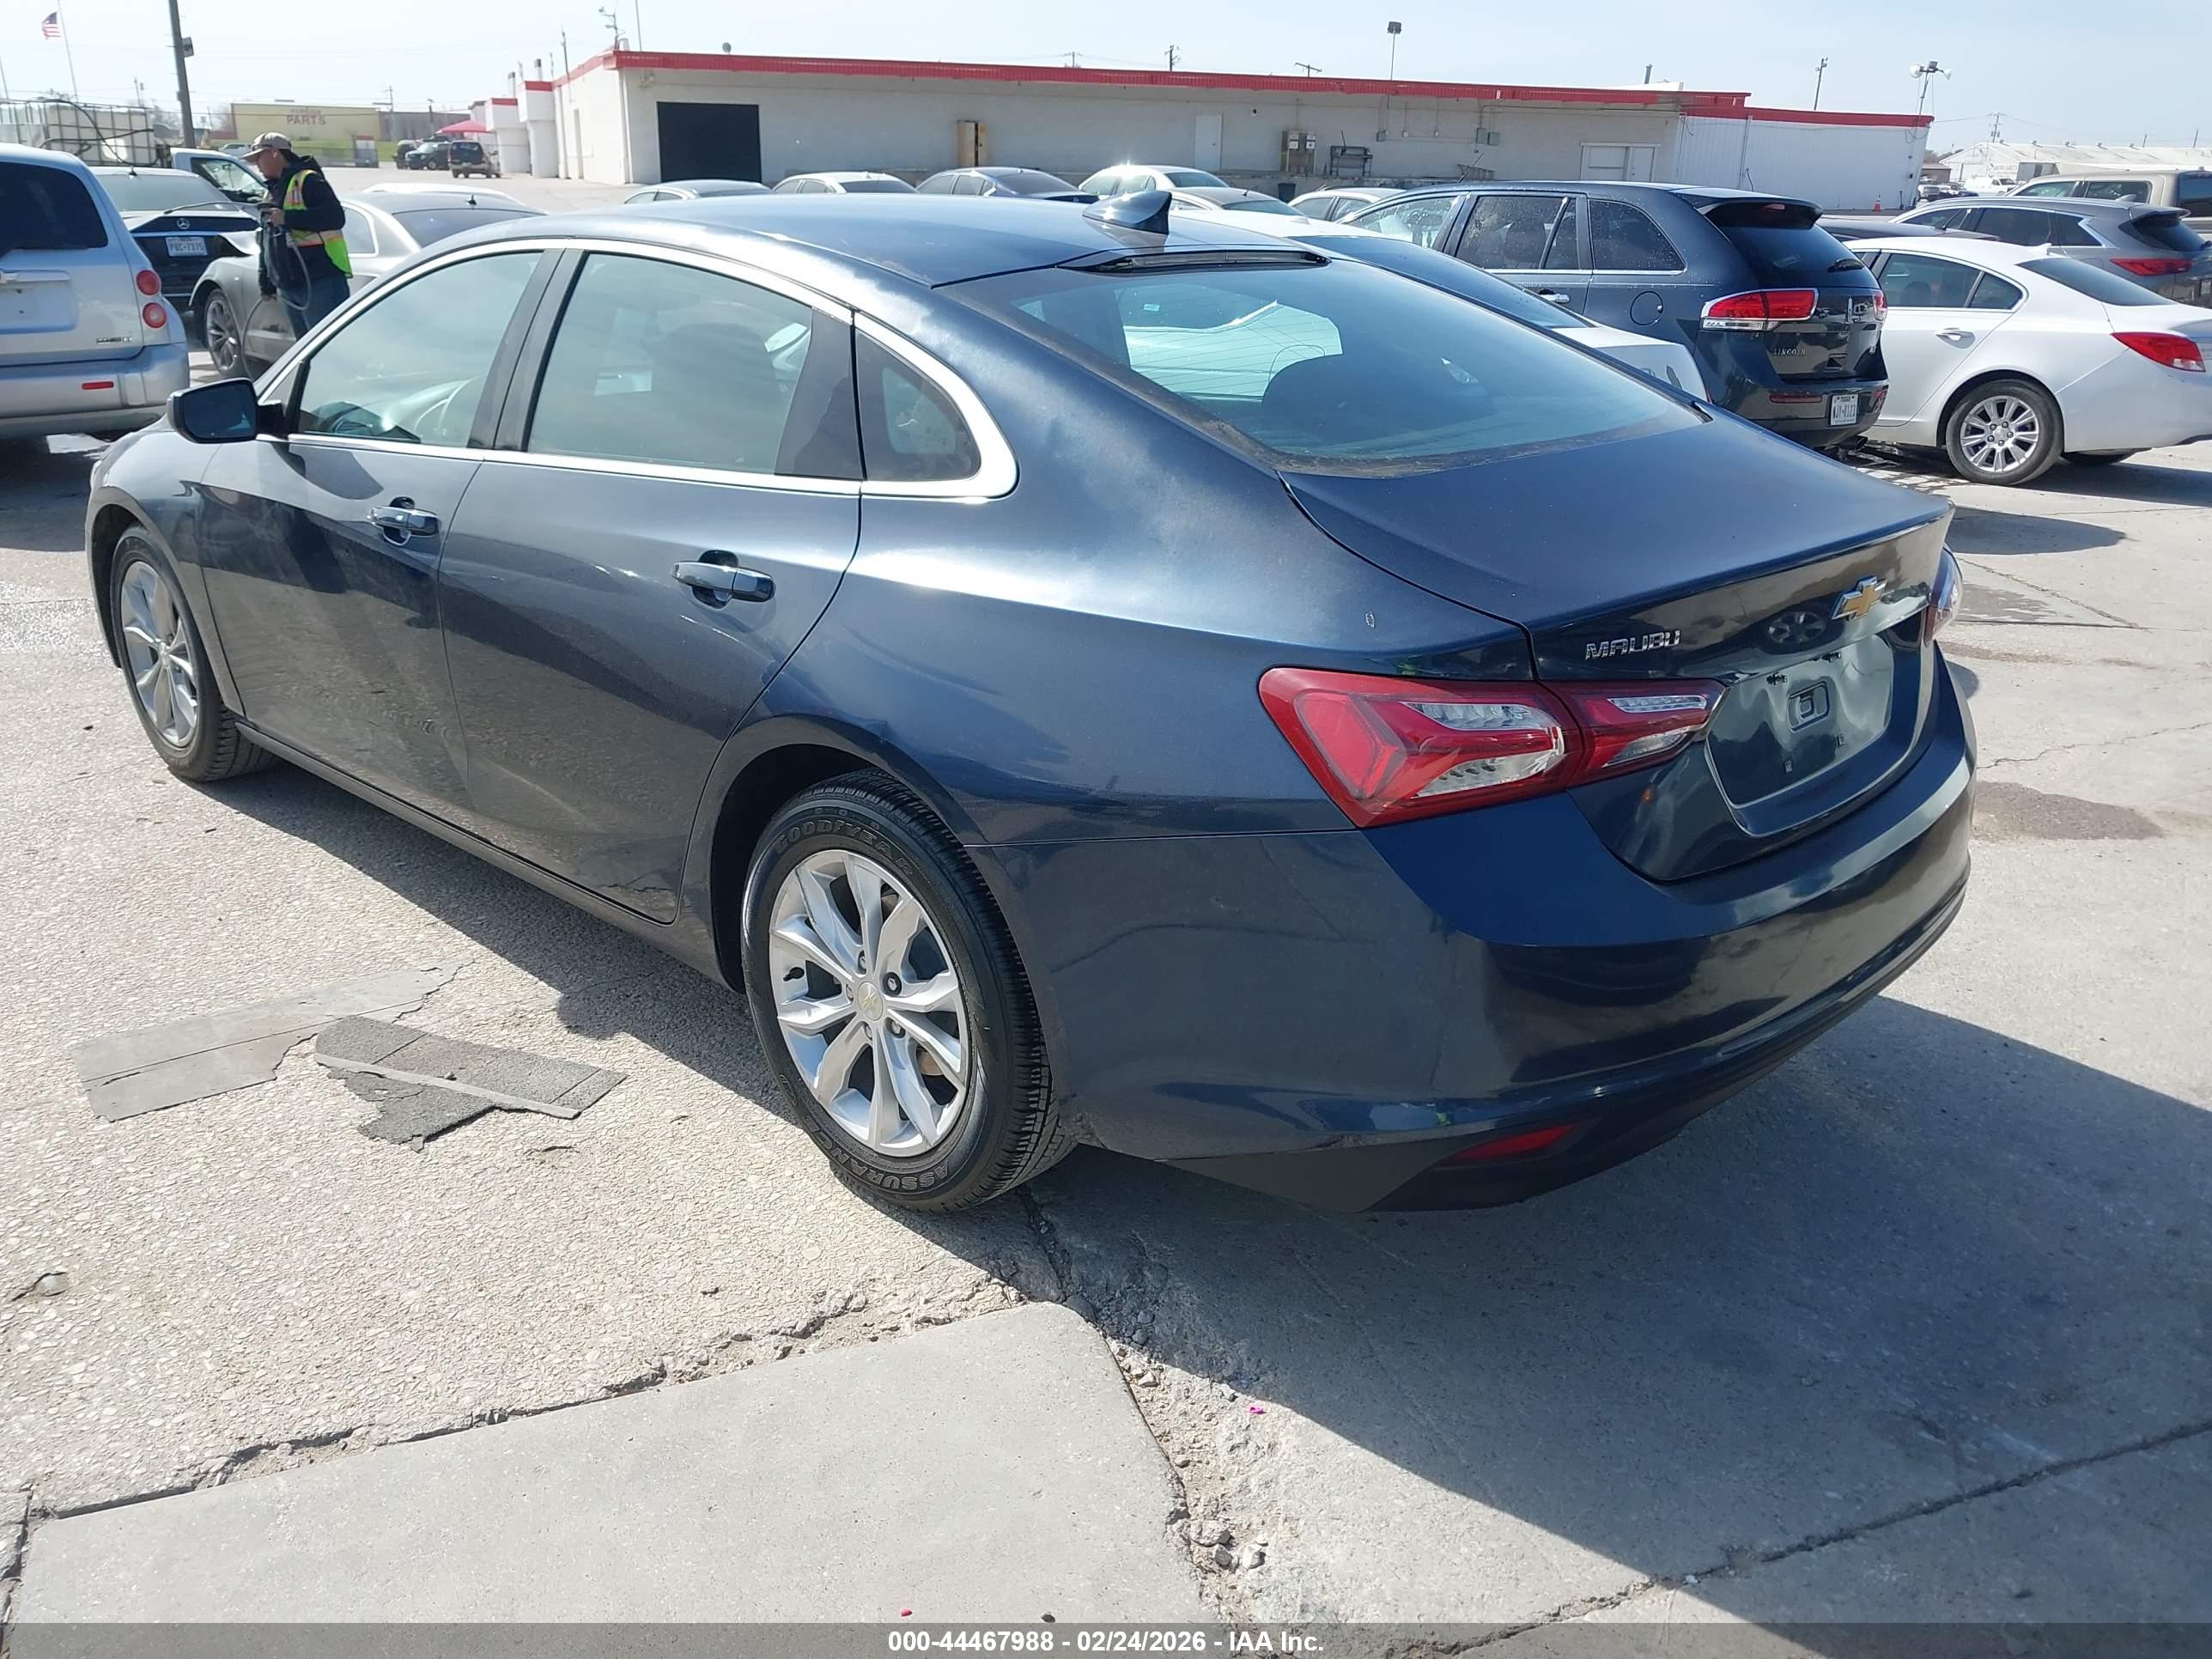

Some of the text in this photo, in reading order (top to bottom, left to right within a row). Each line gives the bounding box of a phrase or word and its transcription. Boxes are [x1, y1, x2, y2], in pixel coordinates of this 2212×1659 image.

[286, 114, 326, 125] PARTS
[1772, 347, 1806, 356] LINCOLN
[1585, 630, 1680, 659] MALIBU
[775, 819, 913, 876] GOODYEAR
[802, 1115, 949, 1190] ASSURANCE
